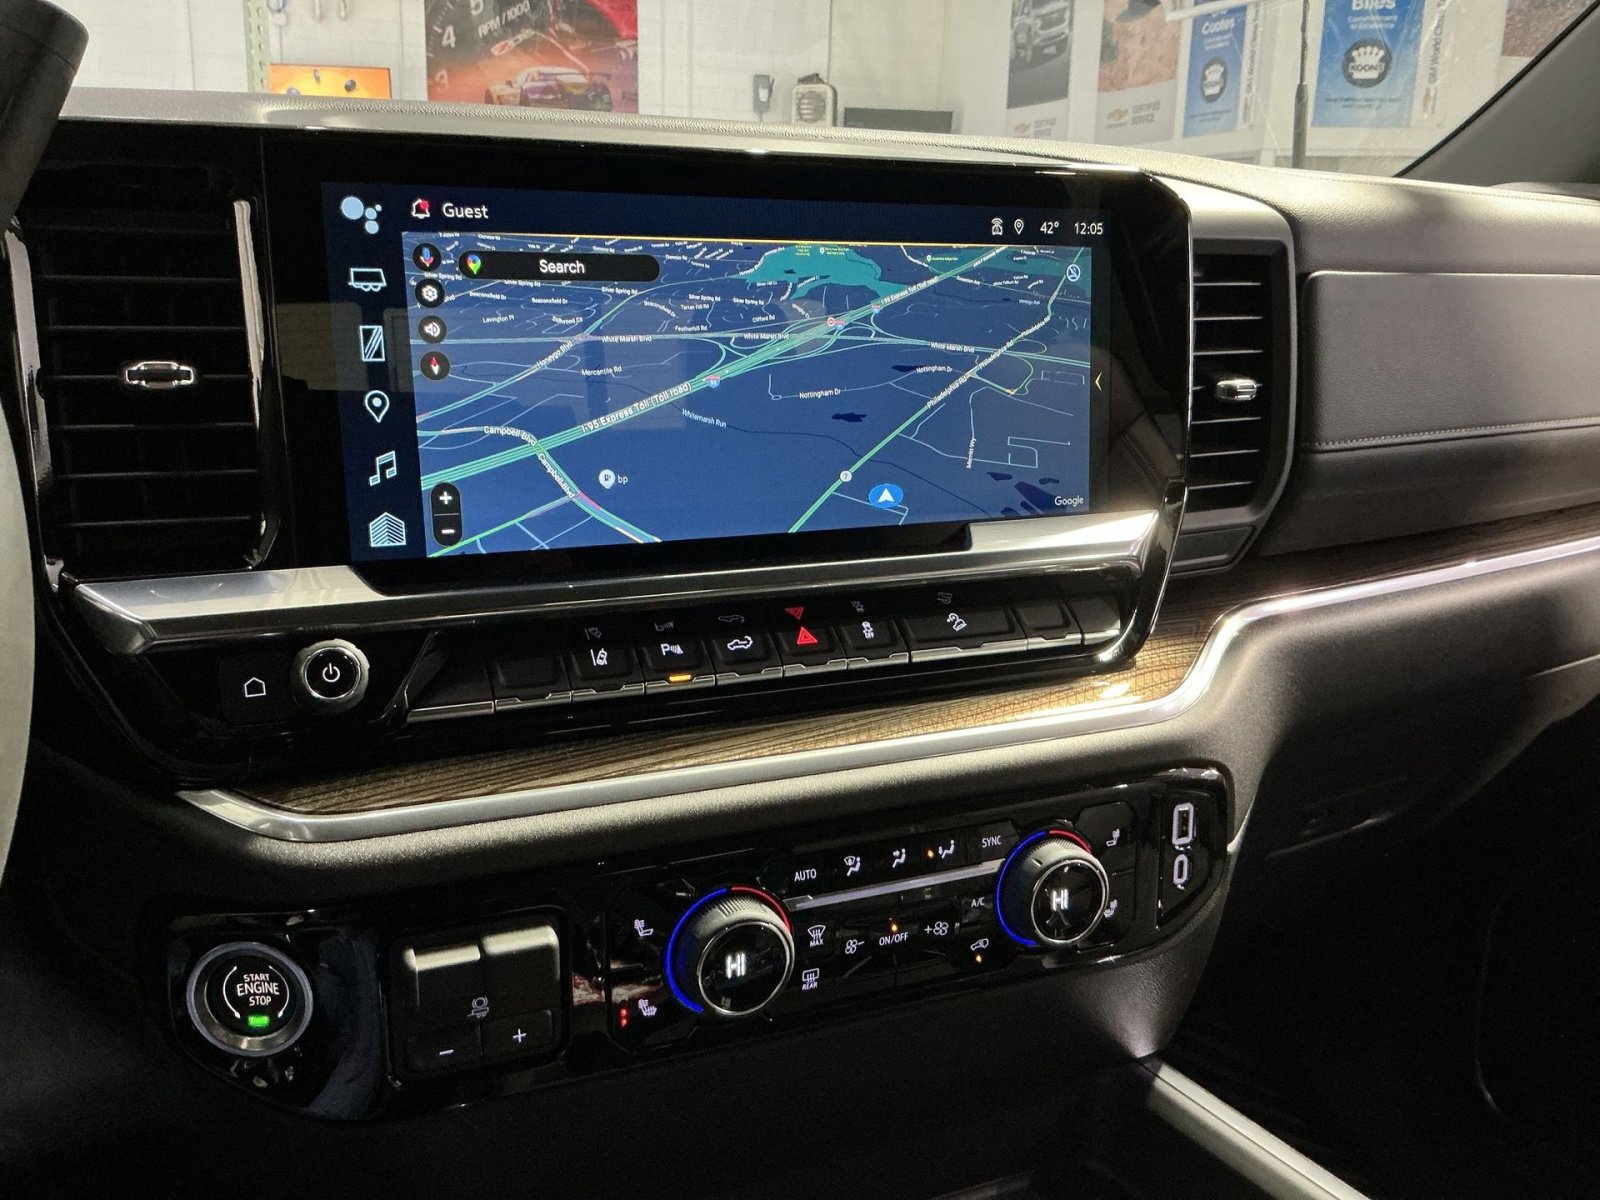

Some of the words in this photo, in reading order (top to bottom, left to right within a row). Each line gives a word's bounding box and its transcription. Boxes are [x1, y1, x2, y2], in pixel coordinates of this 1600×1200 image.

[442, 25, 456, 48] 4
[442, 203, 489, 219] Guest
[1074, 222, 1104, 235] 12:05
[539, 259, 586, 274] Search
[469, 291, 500, 299] Beaconsfield
[615, 287, 631, 295] Spring
[701, 294, 714, 302] Spring
[930, 341, 945, 350] White
[945, 343, 963, 351] Marsh
[963, 345, 975, 353] Blvd
[536, 350, 561, 368] Honeygo
[559, 340, 573, 354] Blvd
[978, 345, 1008, 370] Philadelphia
[1006, 339, 1015, 350] Rd
[581, 368, 613, 376] Mercantile
[613, 365, 622, 373] Rd
[916, 366, 946, 374] Nottingham
[799, 389, 834, 399] Nottingham
[926, 379, 960, 408] Philadelphia
[958, 375, 968, 386] Rd
[581, 420, 599, 433] I-95
[600, 407, 633, 426] Express
[634, 398, 650, 412] Toll
[650, 391, 669, 407] (Toll
[669, 381, 692, 397] road)
[682, 408, 715, 425] Whitemarsh
[715, 418, 727, 428] Run
[483, 425, 521, 438] Campbell
[520, 431, 537, 447] Blvd
[538, 453, 564, 485] Campbell
[561, 481, 576, 500] Blvd
[617, 474, 628, 485] bp
[1054, 495, 1084, 507] Google
[981, 835, 1002, 848] SYNC
[794, 868, 817, 882] AUTO
[971, 896, 985, 908] A/C
[1052, 888, 1069, 912] HI
[809, 938, 824, 948] MAX
[879, 931, 909, 946] ON/OFF
[725, 952, 747, 979] HI
[243, 972, 270, 983] START
[236, 981, 280, 997] ENGINE
[802, 981, 818, 991] REAR
[248, 995, 272, 1007] STOP
